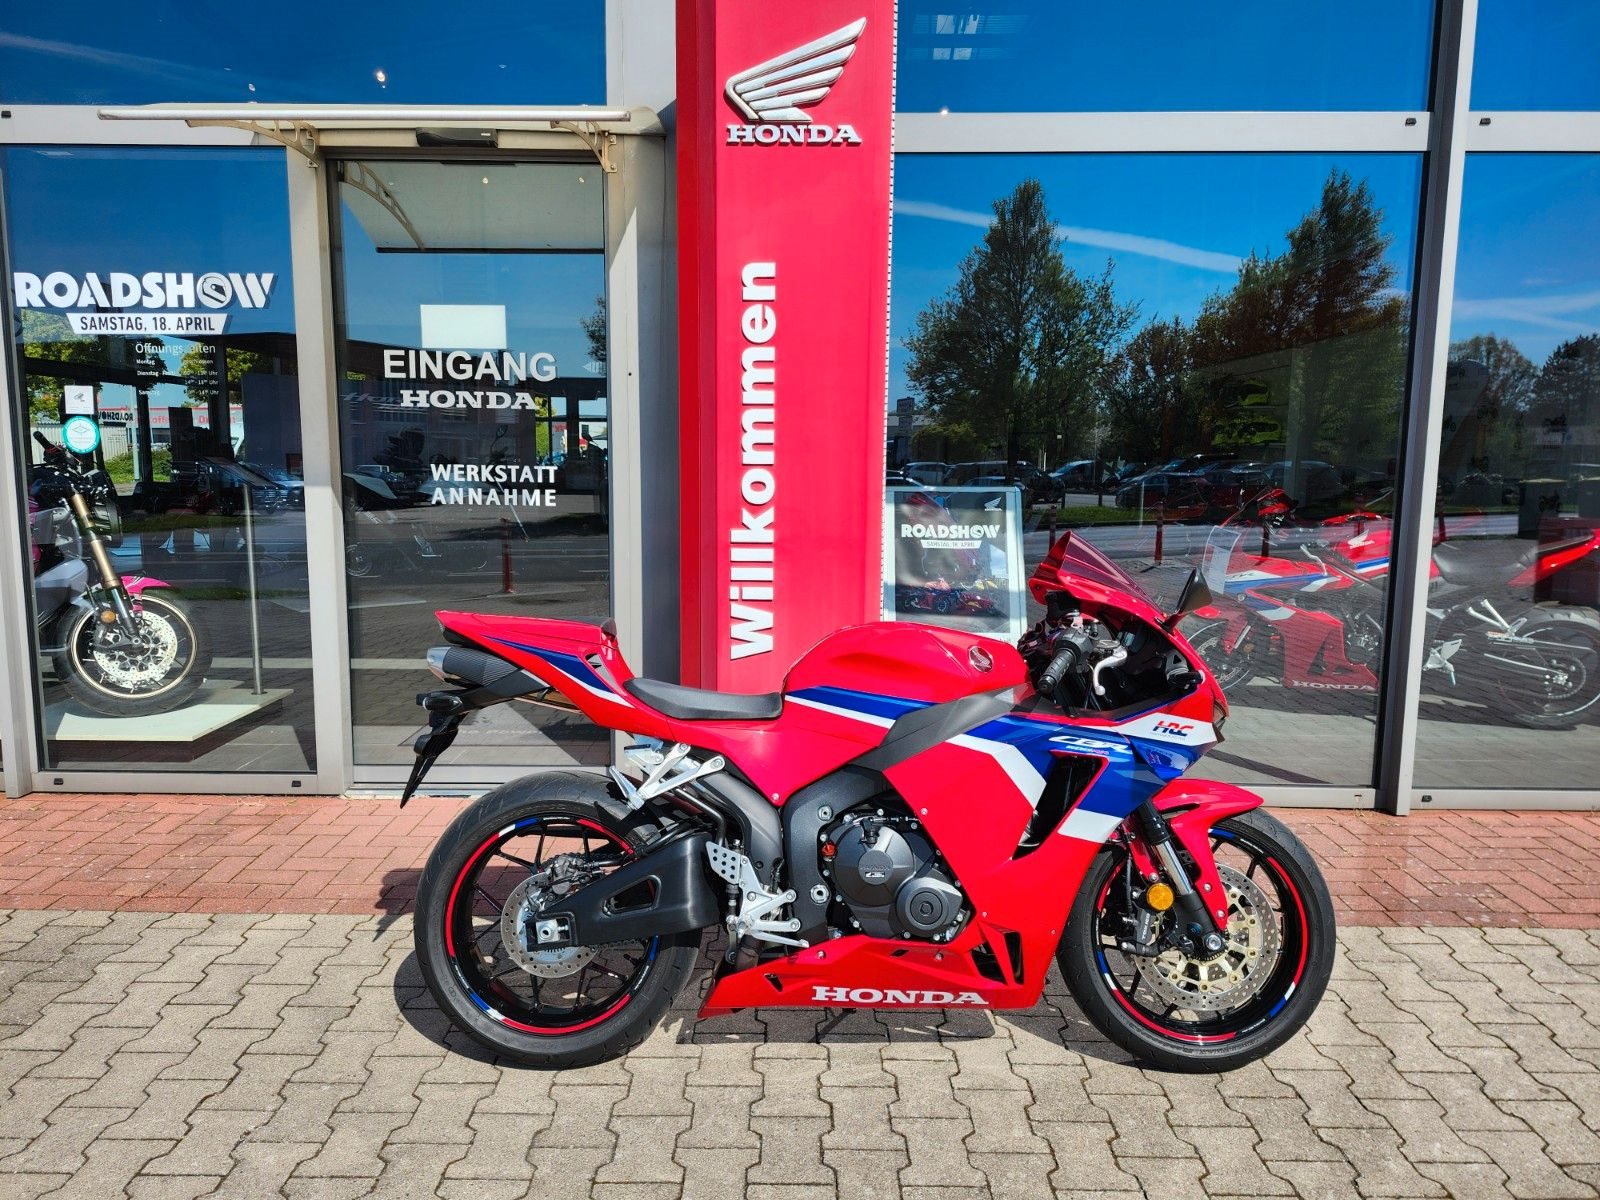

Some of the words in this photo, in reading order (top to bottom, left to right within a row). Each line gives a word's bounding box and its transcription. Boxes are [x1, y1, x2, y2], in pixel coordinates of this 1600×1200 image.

[726, 124, 862, 145] HONDA
[13, 272, 274, 309] ROADSHOW
[80, 316, 148, 332] SAMSTAG,
[152, 316, 172, 331] 18.
[177, 316, 215, 331] APRIL
[135, 341, 216, 356] Öffnungseiten
[384, 350, 557, 382] EINGANG
[400, 389, 539, 410] HONDA
[729, 261, 776, 660] Willkommen
[430, 463, 558, 484] WERKSTATT
[431, 487, 557, 507] ANNAHME
[901, 523, 1000, 539] ROADSHOW
[1292, 680, 1377, 691] HONDA
[1153, 720, 1194, 737] HRC
[812, 985, 989, 1005] HONDA
